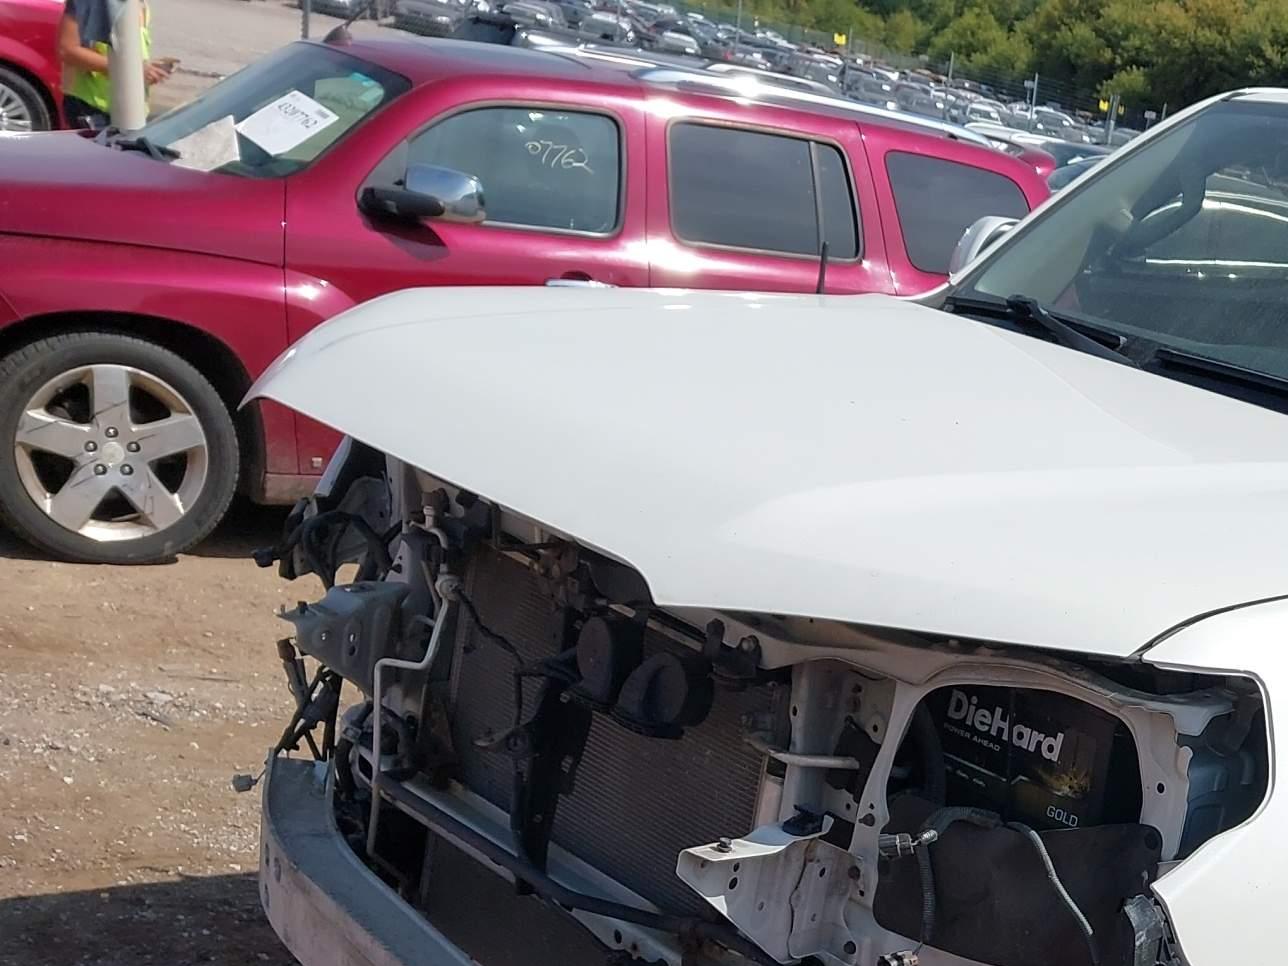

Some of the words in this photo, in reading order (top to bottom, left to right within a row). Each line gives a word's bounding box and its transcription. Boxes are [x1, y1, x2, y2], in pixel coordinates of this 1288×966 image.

[525, 140, 595, 175] 07762
[943, 722, 971, 740] POWER
[972, 735, 1000, 752] AHEAD
[947, 688, 1065, 762] DieHard
[1046, 805, 1079, 827] GOLD
